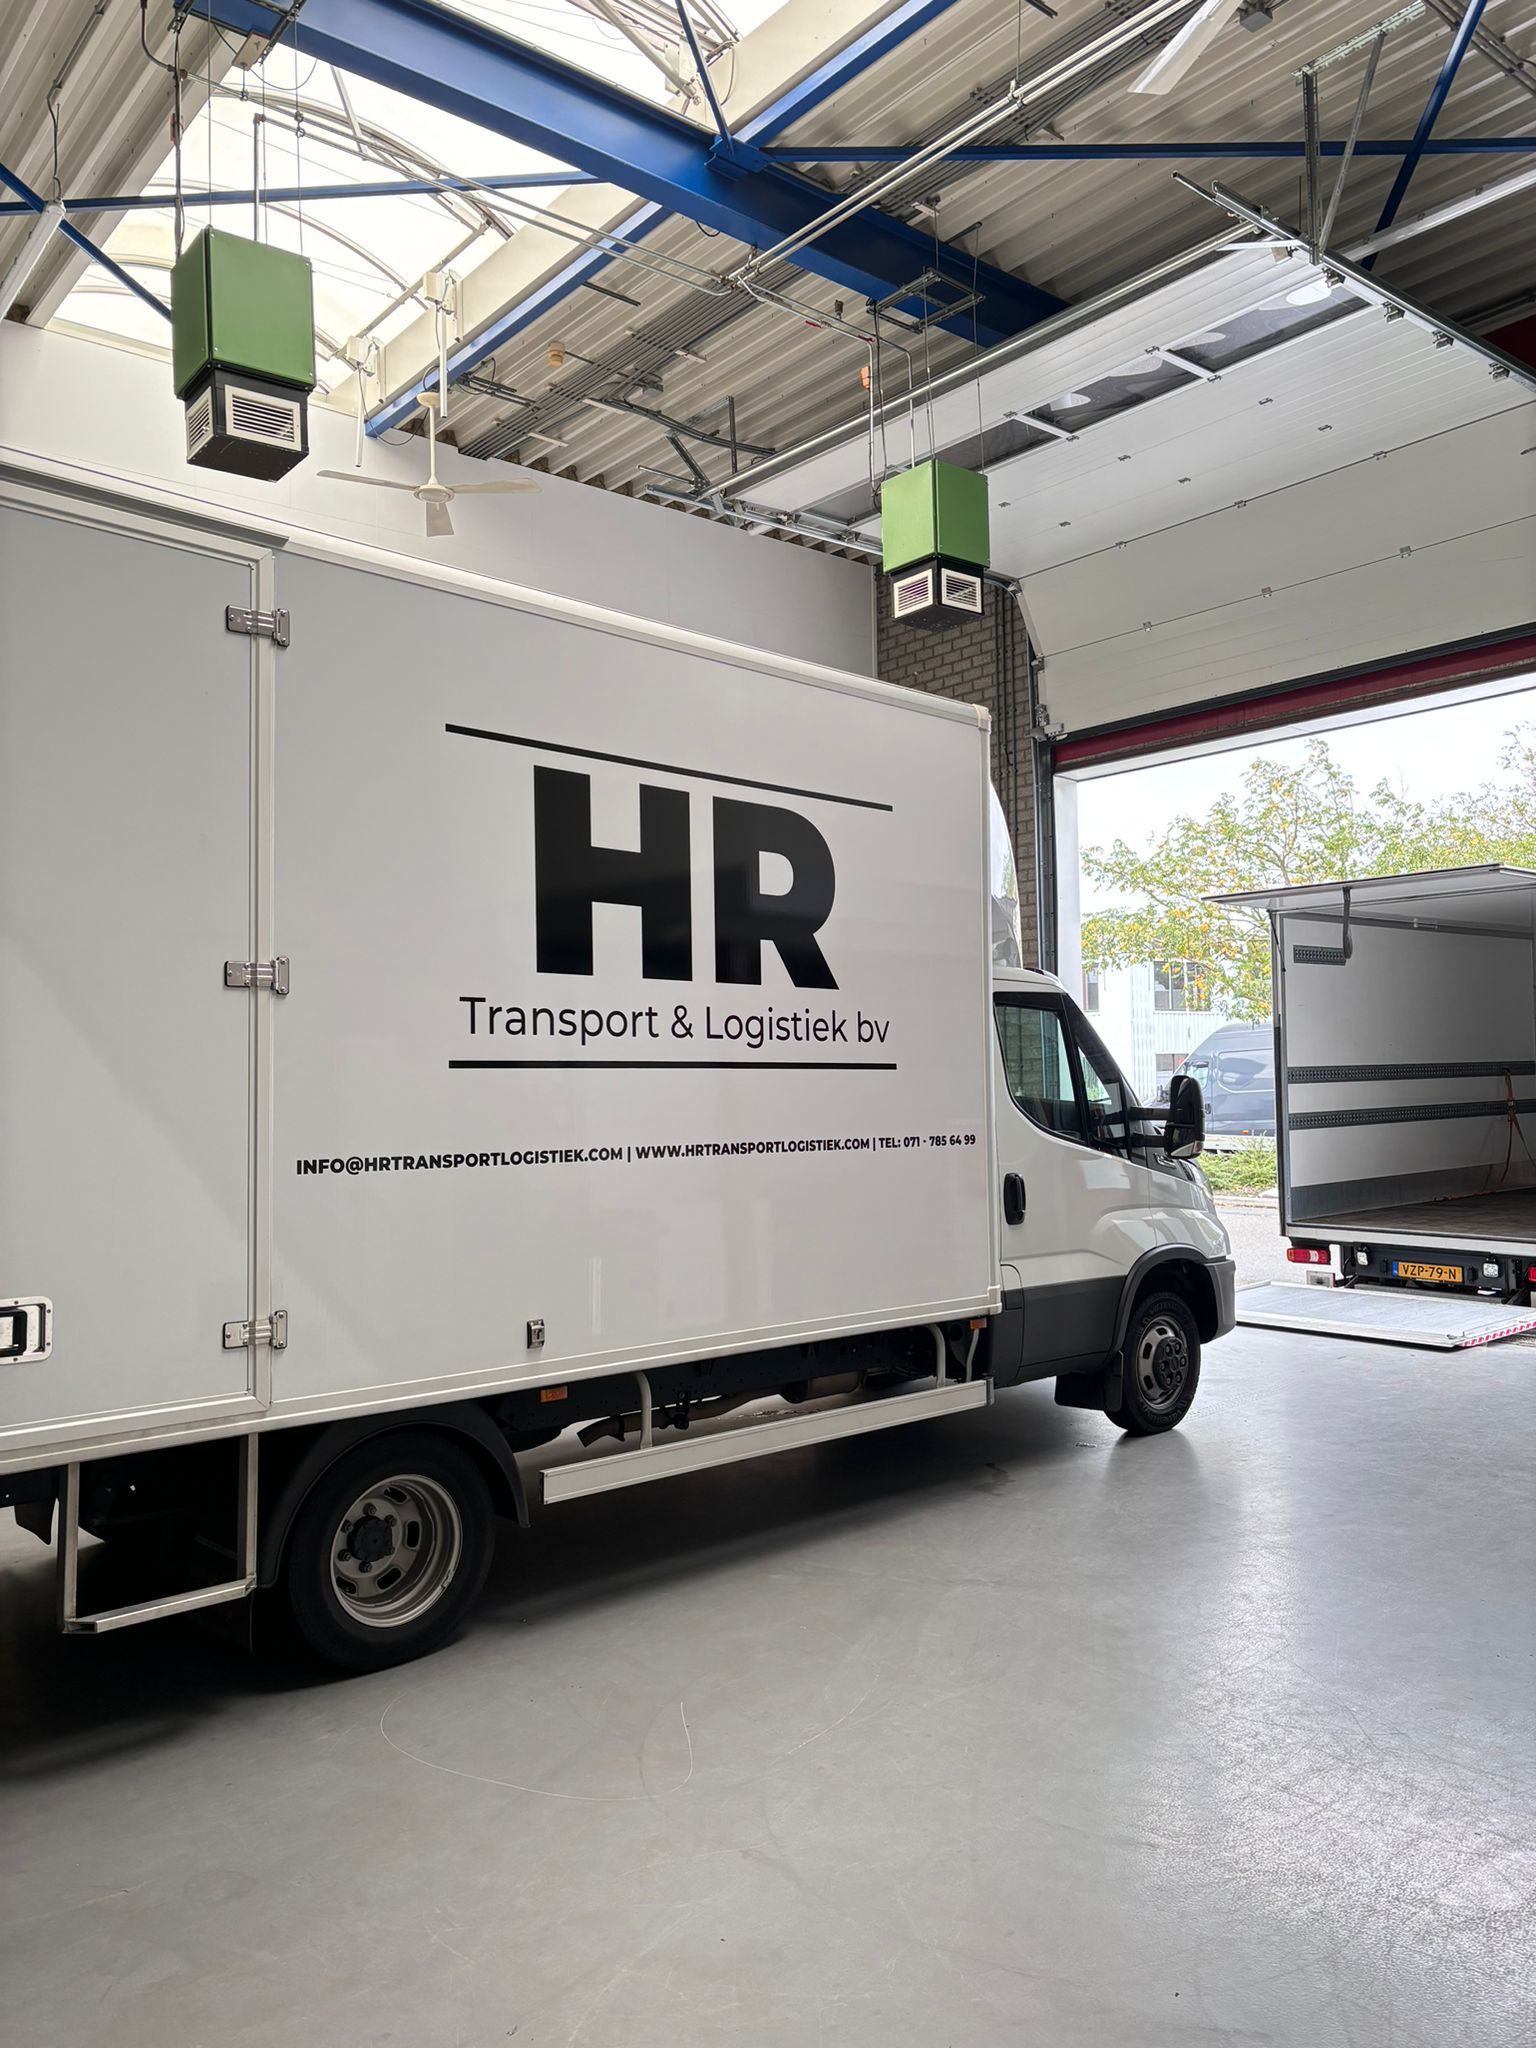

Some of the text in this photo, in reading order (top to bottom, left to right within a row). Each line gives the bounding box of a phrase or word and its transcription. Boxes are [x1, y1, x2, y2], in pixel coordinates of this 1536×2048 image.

[533, 764, 840, 991] HR
[459, 996, 890, 1050] Transport & Logistiek bv
[296, 1147, 623, 1176] INFO@HRTRANSPORTLOGISTIEK.COM
[635, 1137, 870, 1161] WWW.HRTRANSPORTLOGISTIEK.COM
[878, 1136, 902, 1149] TEL:
[903, 1136, 921, 1148] 071
[928, 1135, 948, 1147] 785
[949, 1134, 963, 1146] 64
[963, 1133, 977, 1146] 99
[1402, 1264, 1457, 1280] VZP-79-N
